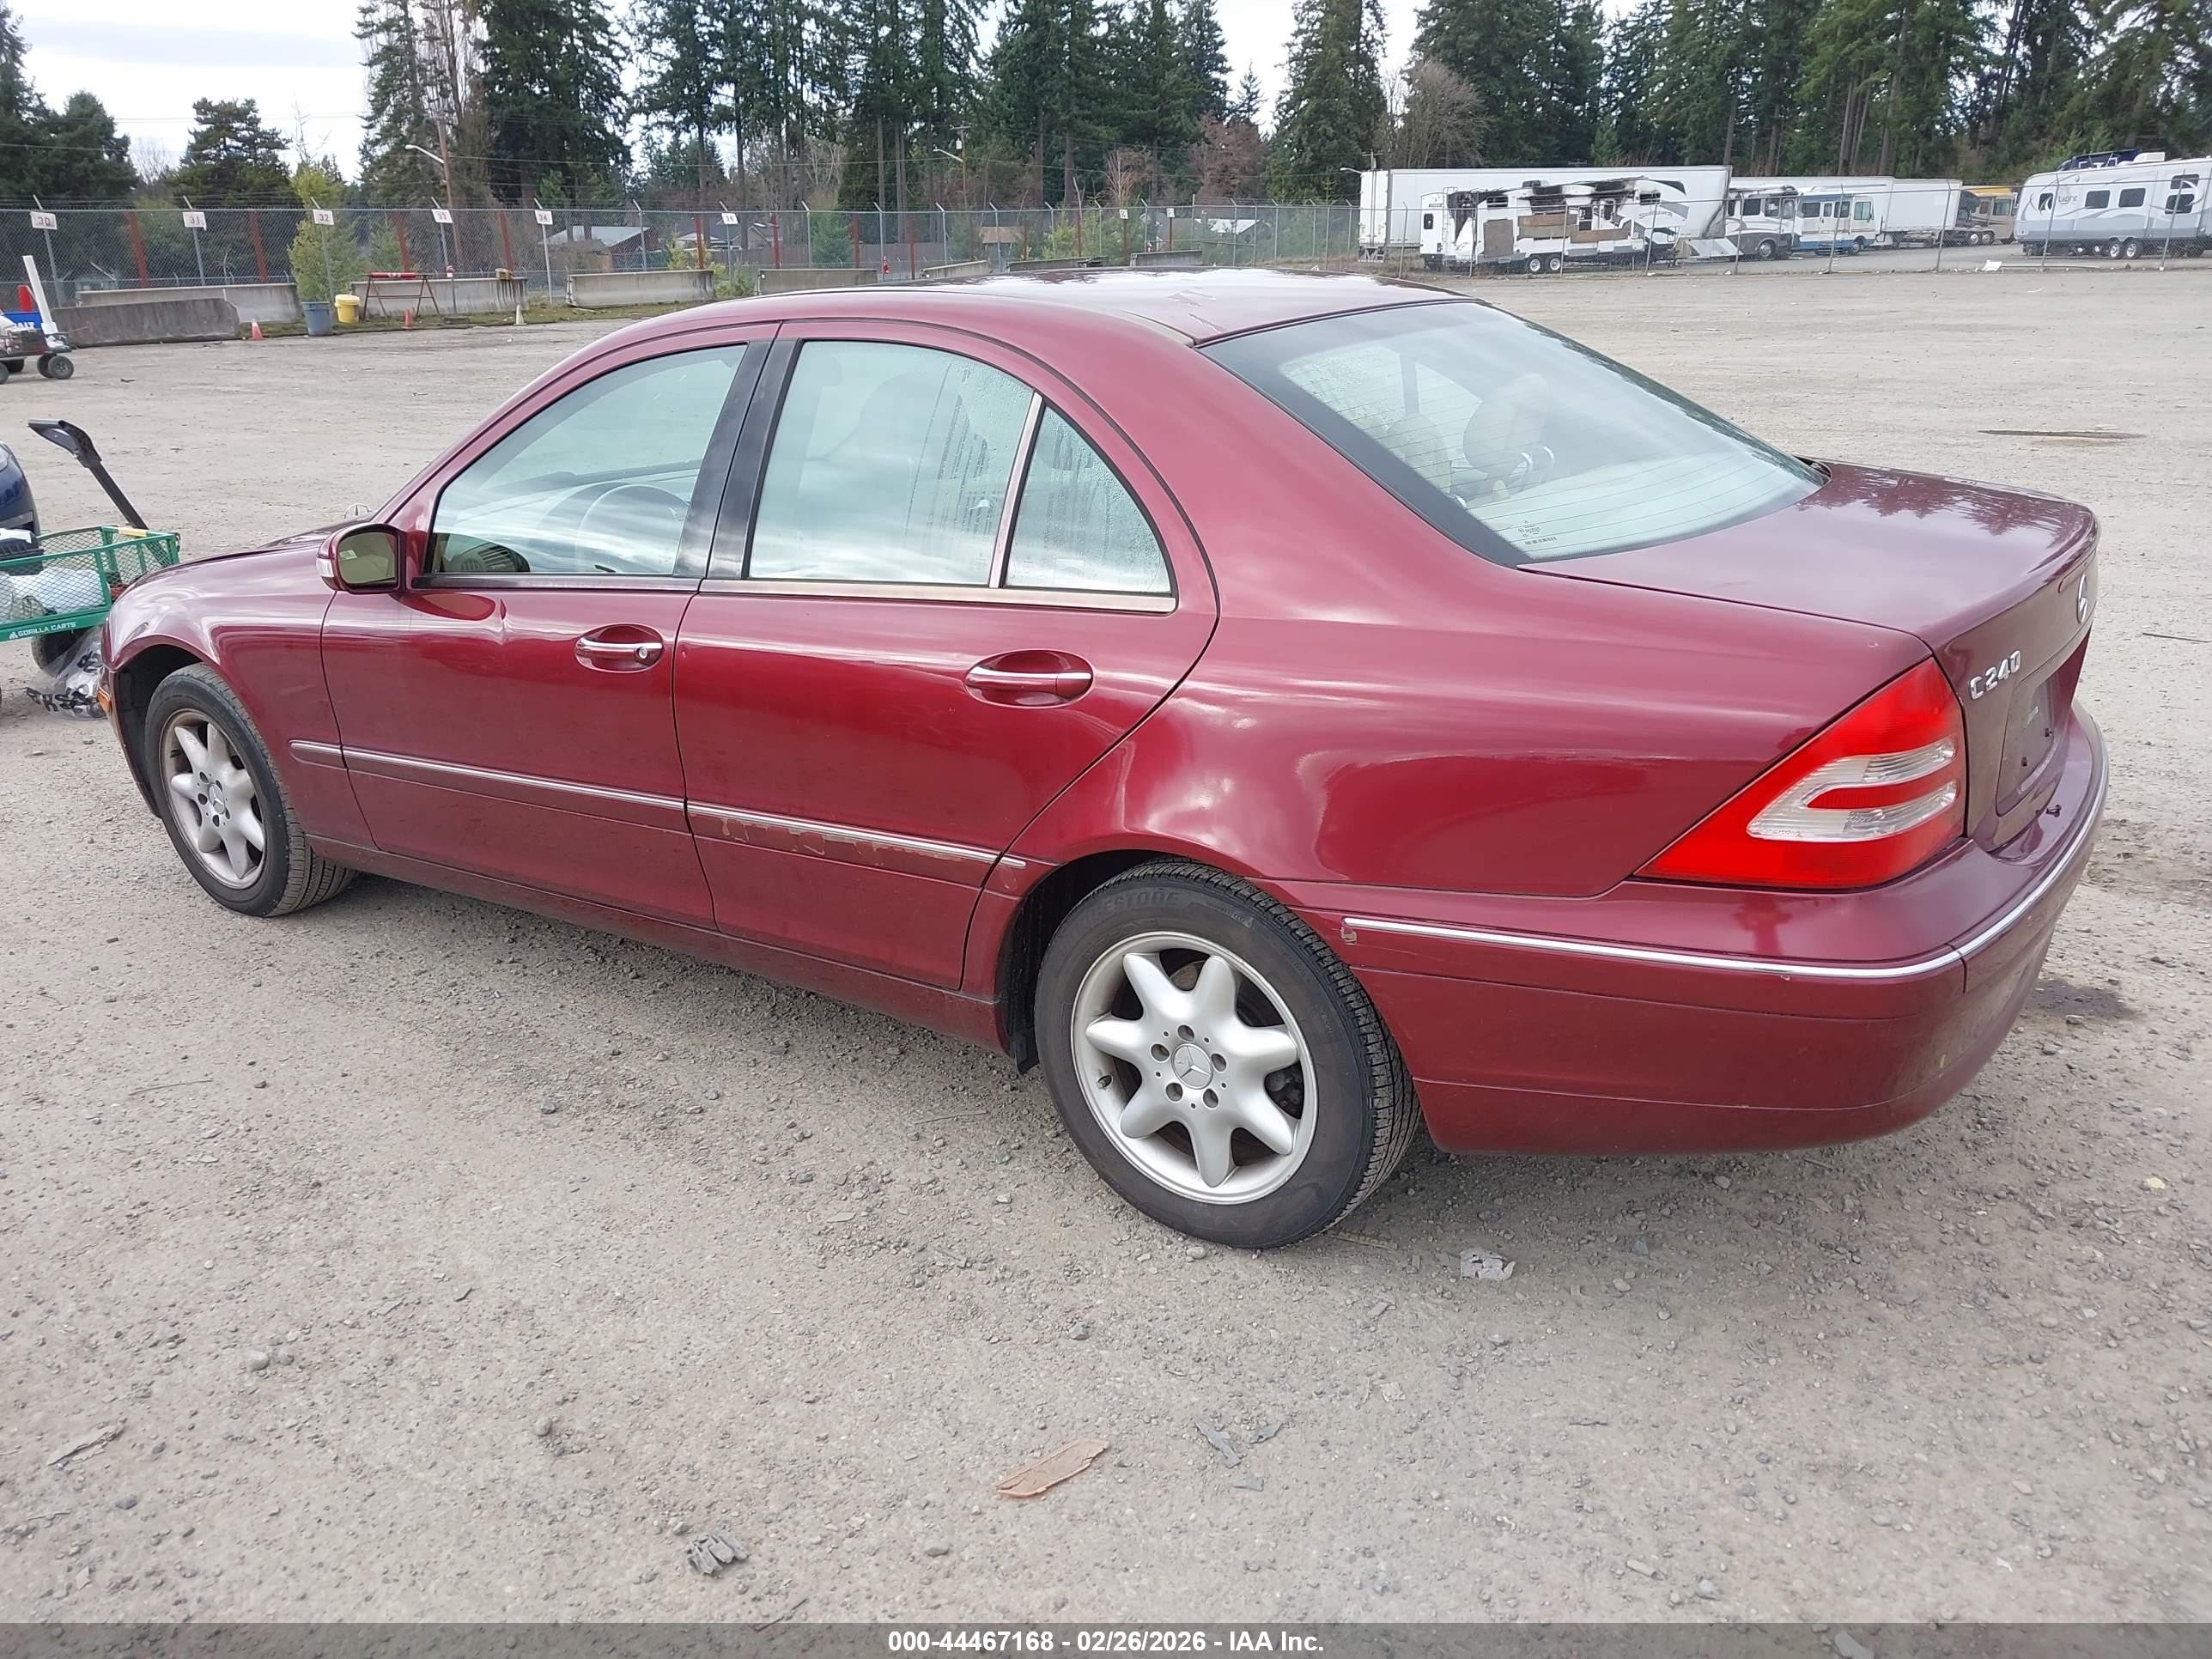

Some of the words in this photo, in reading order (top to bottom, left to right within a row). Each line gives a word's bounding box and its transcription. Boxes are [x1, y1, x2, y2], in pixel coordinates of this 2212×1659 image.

[38, 216, 51, 227] 30
[190, 216, 200, 224] 31
[319, 213, 329, 222] 32
[18, 626, 50, 637] GORILLA
[51, 622, 76, 631] CARTS
